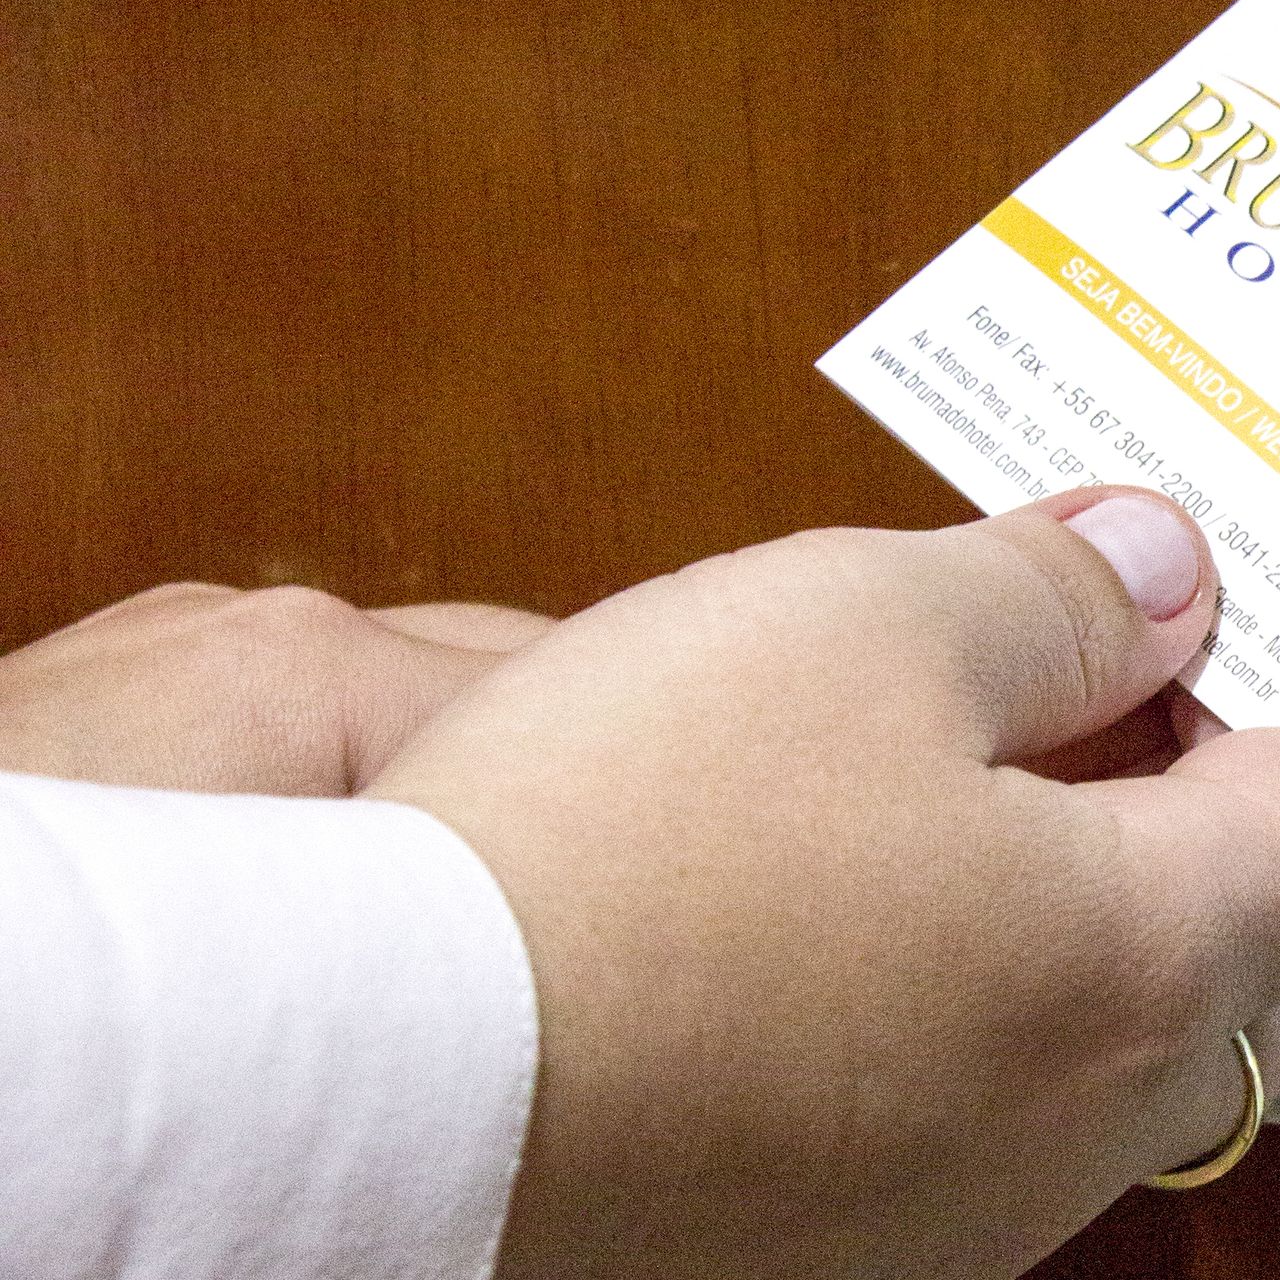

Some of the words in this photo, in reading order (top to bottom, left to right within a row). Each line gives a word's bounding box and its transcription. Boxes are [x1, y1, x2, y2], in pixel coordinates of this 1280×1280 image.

[909, 329, 933, 353] Av.
[930, 346, 978, 390] Afonso
[975, 383, 1012, 424] Pena,
[1012, 414, 1046, 446] 743
[1049, 447, 1084, 477] CEP
[1060, 257, 1122, 312] SEJA
[1115, 303, 1243, 412] BEM-VINDO
[870, 345, 1050, 501] www.brumadohotel.com.br
[1012, 343, 1050, 380] Fax:
[1089, 409, 1121, 435] 67
[1114, 431, 1213, 518] 3041-2200
